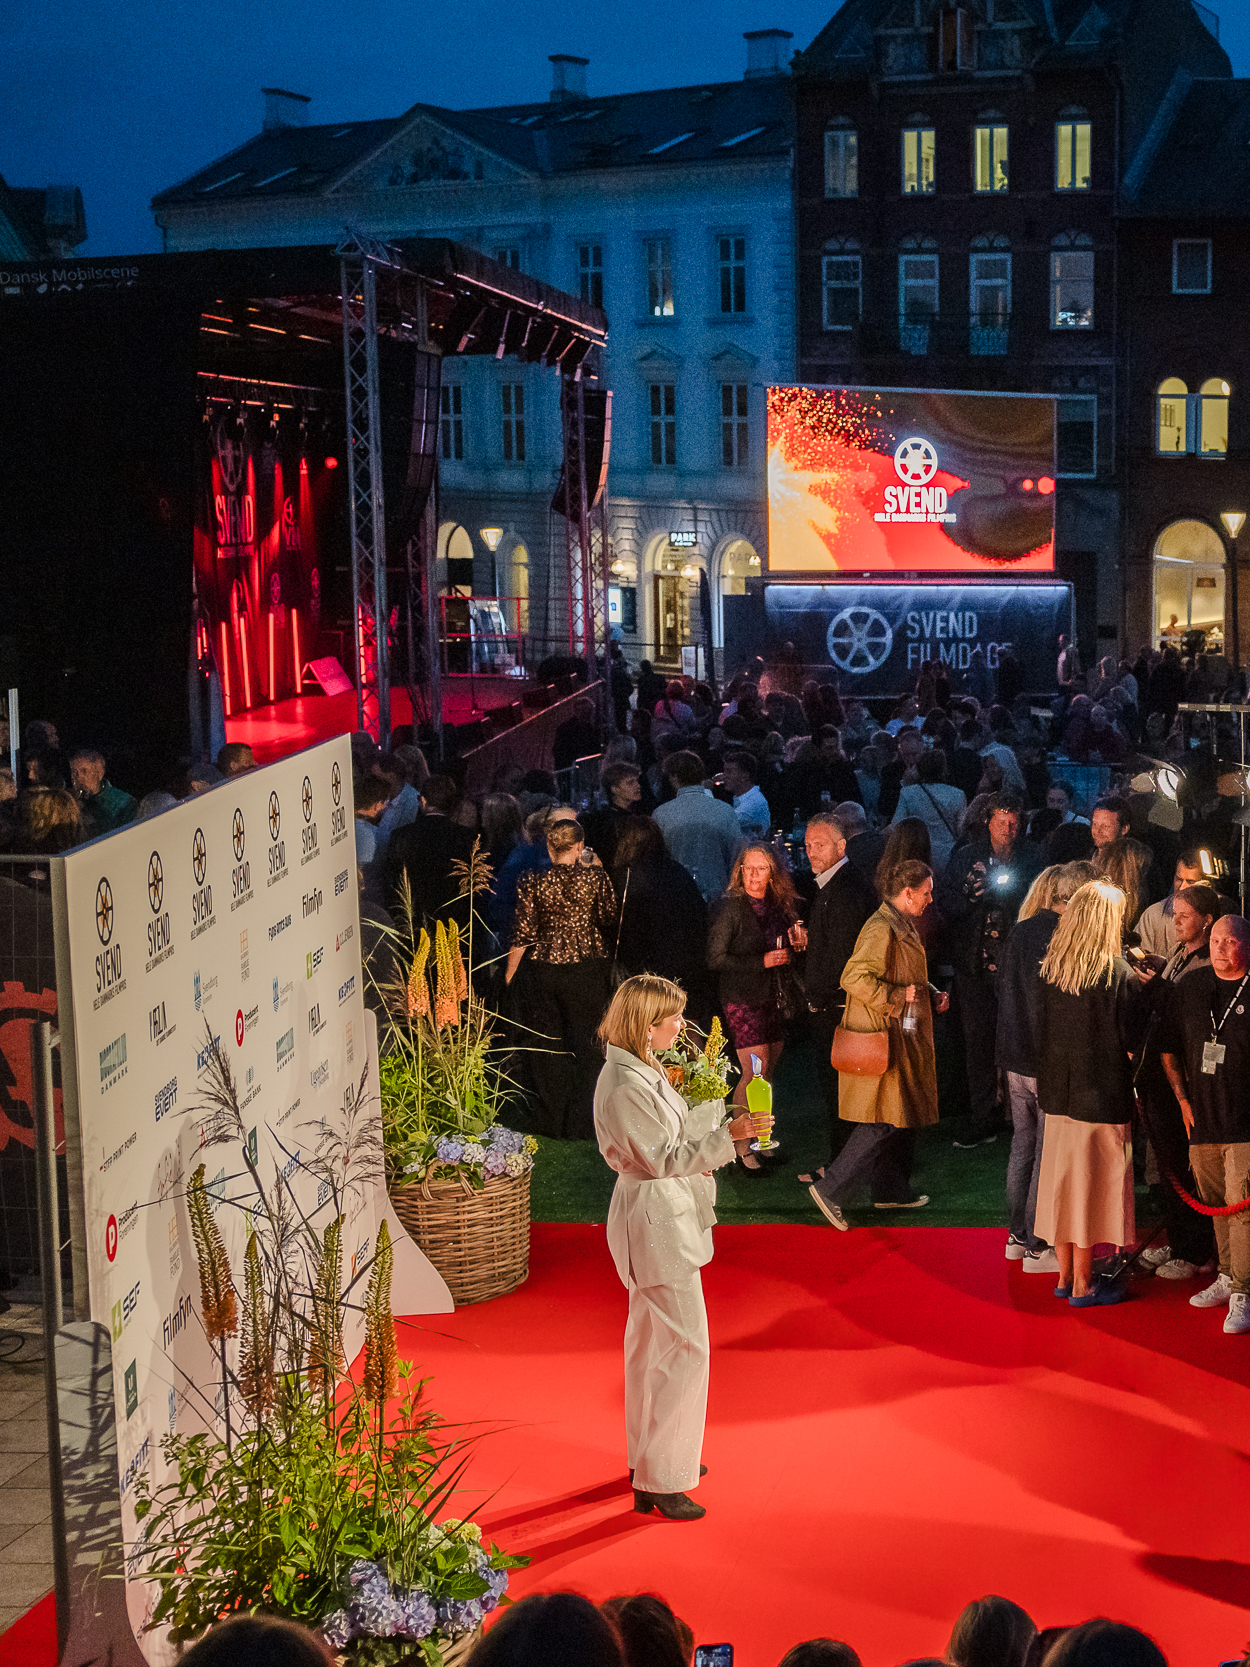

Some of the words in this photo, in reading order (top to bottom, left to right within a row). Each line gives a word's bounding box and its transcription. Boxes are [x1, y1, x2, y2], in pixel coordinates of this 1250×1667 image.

[0, 268, 49, 285] Dansk
[52, 265, 140, 281] Mobilscene
[884, 485, 948, 513] SVEND
[215, 494, 255, 545] SVEND
[670, 532, 697, 543] PARK
[905, 611, 978, 639] SVEND
[301, 822, 318, 856] SVEND
[268, 840, 286, 876] SVEND
[231, 860, 251, 899] SVEND
[192, 884, 213, 926] SVEND
[302, 887, 323, 919] Filmfyn
[147, 911, 171, 958] SVEND
[95, 943, 122, 994] SVEND
[101, 1066, 128, 1095] DANMARK
[154, 1075, 178, 1107] SVENDBORG
[154, 1086, 178, 1123] EVENT
[122, 1280, 140, 1321] SEF
[162, 1293, 192, 1351] Filmfyn
